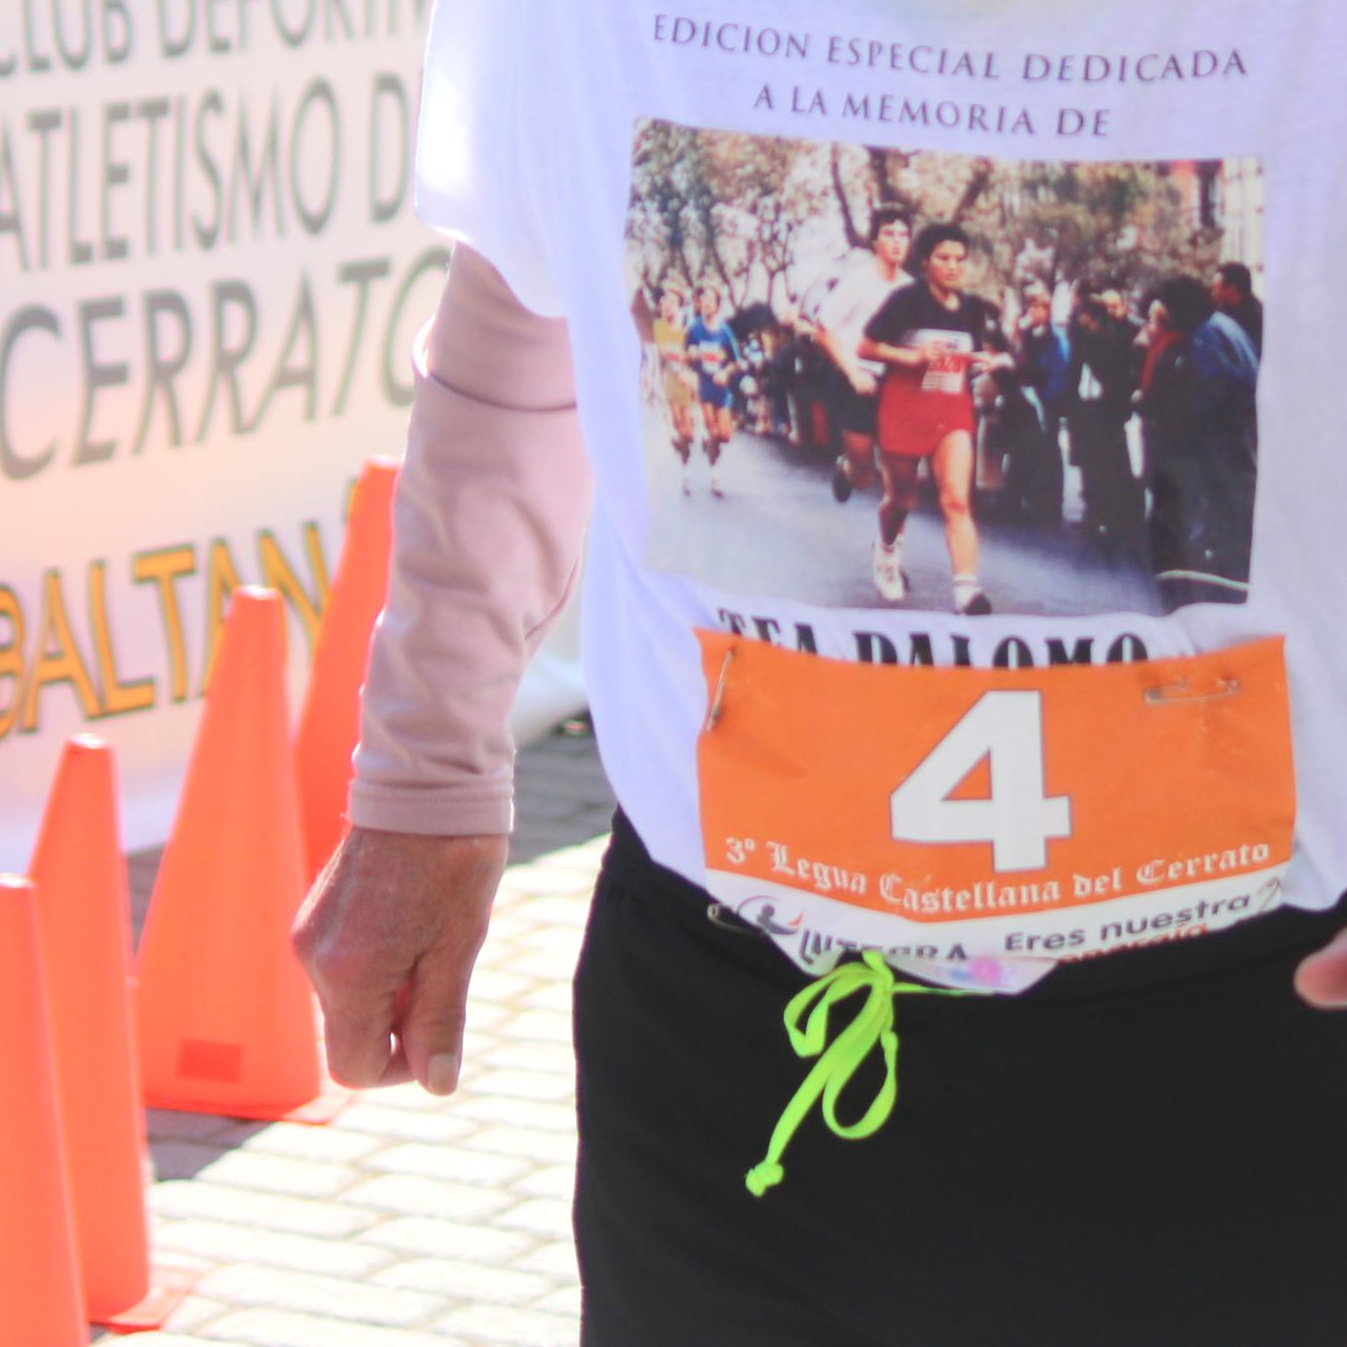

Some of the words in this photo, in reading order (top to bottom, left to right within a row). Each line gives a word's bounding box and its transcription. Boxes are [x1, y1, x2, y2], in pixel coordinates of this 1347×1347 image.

[653, 13, 810, 59] EDICION
[826, 35, 1000, 80] ESPECIAL
[1020, 48, 1248, 83] DEDICADA
[753, 82, 775, 110] A
[790, 85, 828, 116] LA
[841, 91, 1036, 135] MEMORIA
[1056, 107, 1111, 137] DE
[889, 689, 1072, 873] 4
[878, 872, 1061, 914] Castellana
[1072, 866, 1122, 898] del
[1135, 842, 1270, 885] Cerrato
[1004, 927, 1086, 954] Eres
[1100, 892, 1251, 942] nuestra
